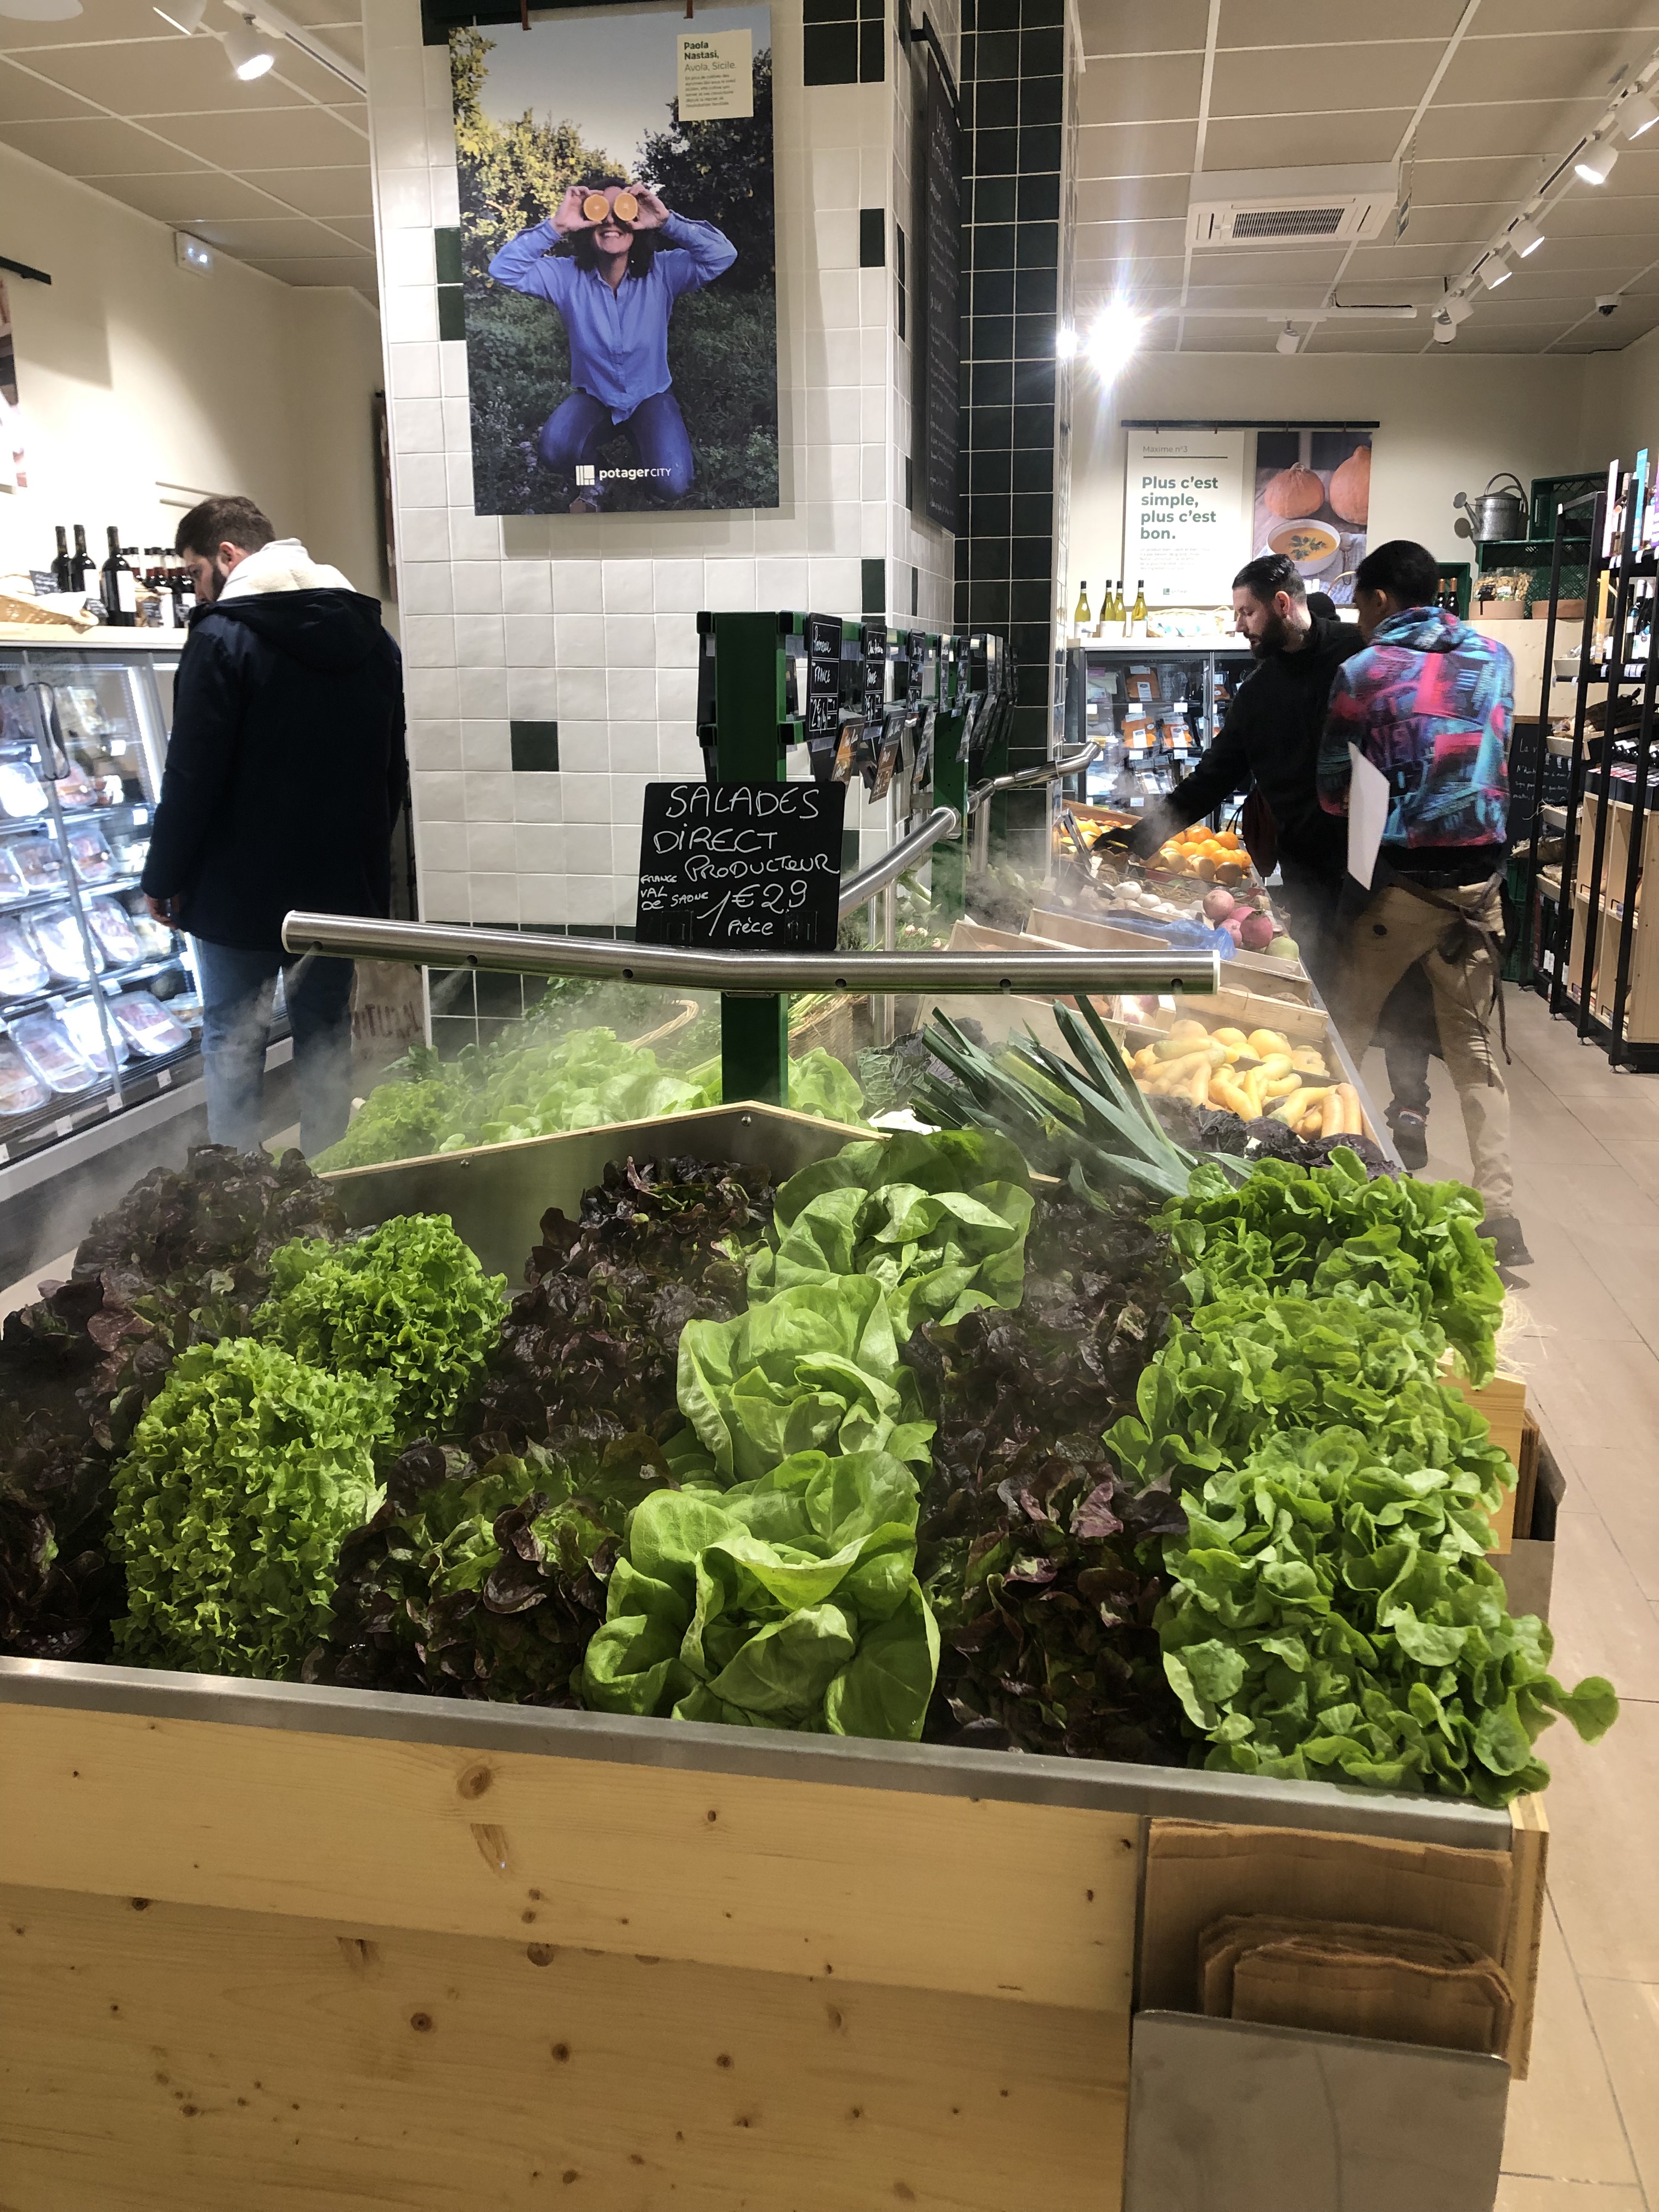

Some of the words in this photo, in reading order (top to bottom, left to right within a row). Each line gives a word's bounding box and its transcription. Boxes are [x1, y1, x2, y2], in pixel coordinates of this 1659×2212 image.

[684, 41, 709, 50] Paola
[684, 50, 719, 60] Nastasi,
[685, 63, 710, 71] Avola,
[712, 61, 737, 70] Sicile.
[1142, 476, 1176, 488] Plus
[1181, 476, 1218, 488] c'est
[1141, 492, 1198, 509] simple,
[1141, 510, 1174, 525] plus
[1179, 510, 1216, 522] c'est
[1141, 527, 1176, 539] bon.
[665, 785, 820, 819] SALADES
[653, 823, 778, 854] DIRECT
[640, 886, 668, 899] VAL
